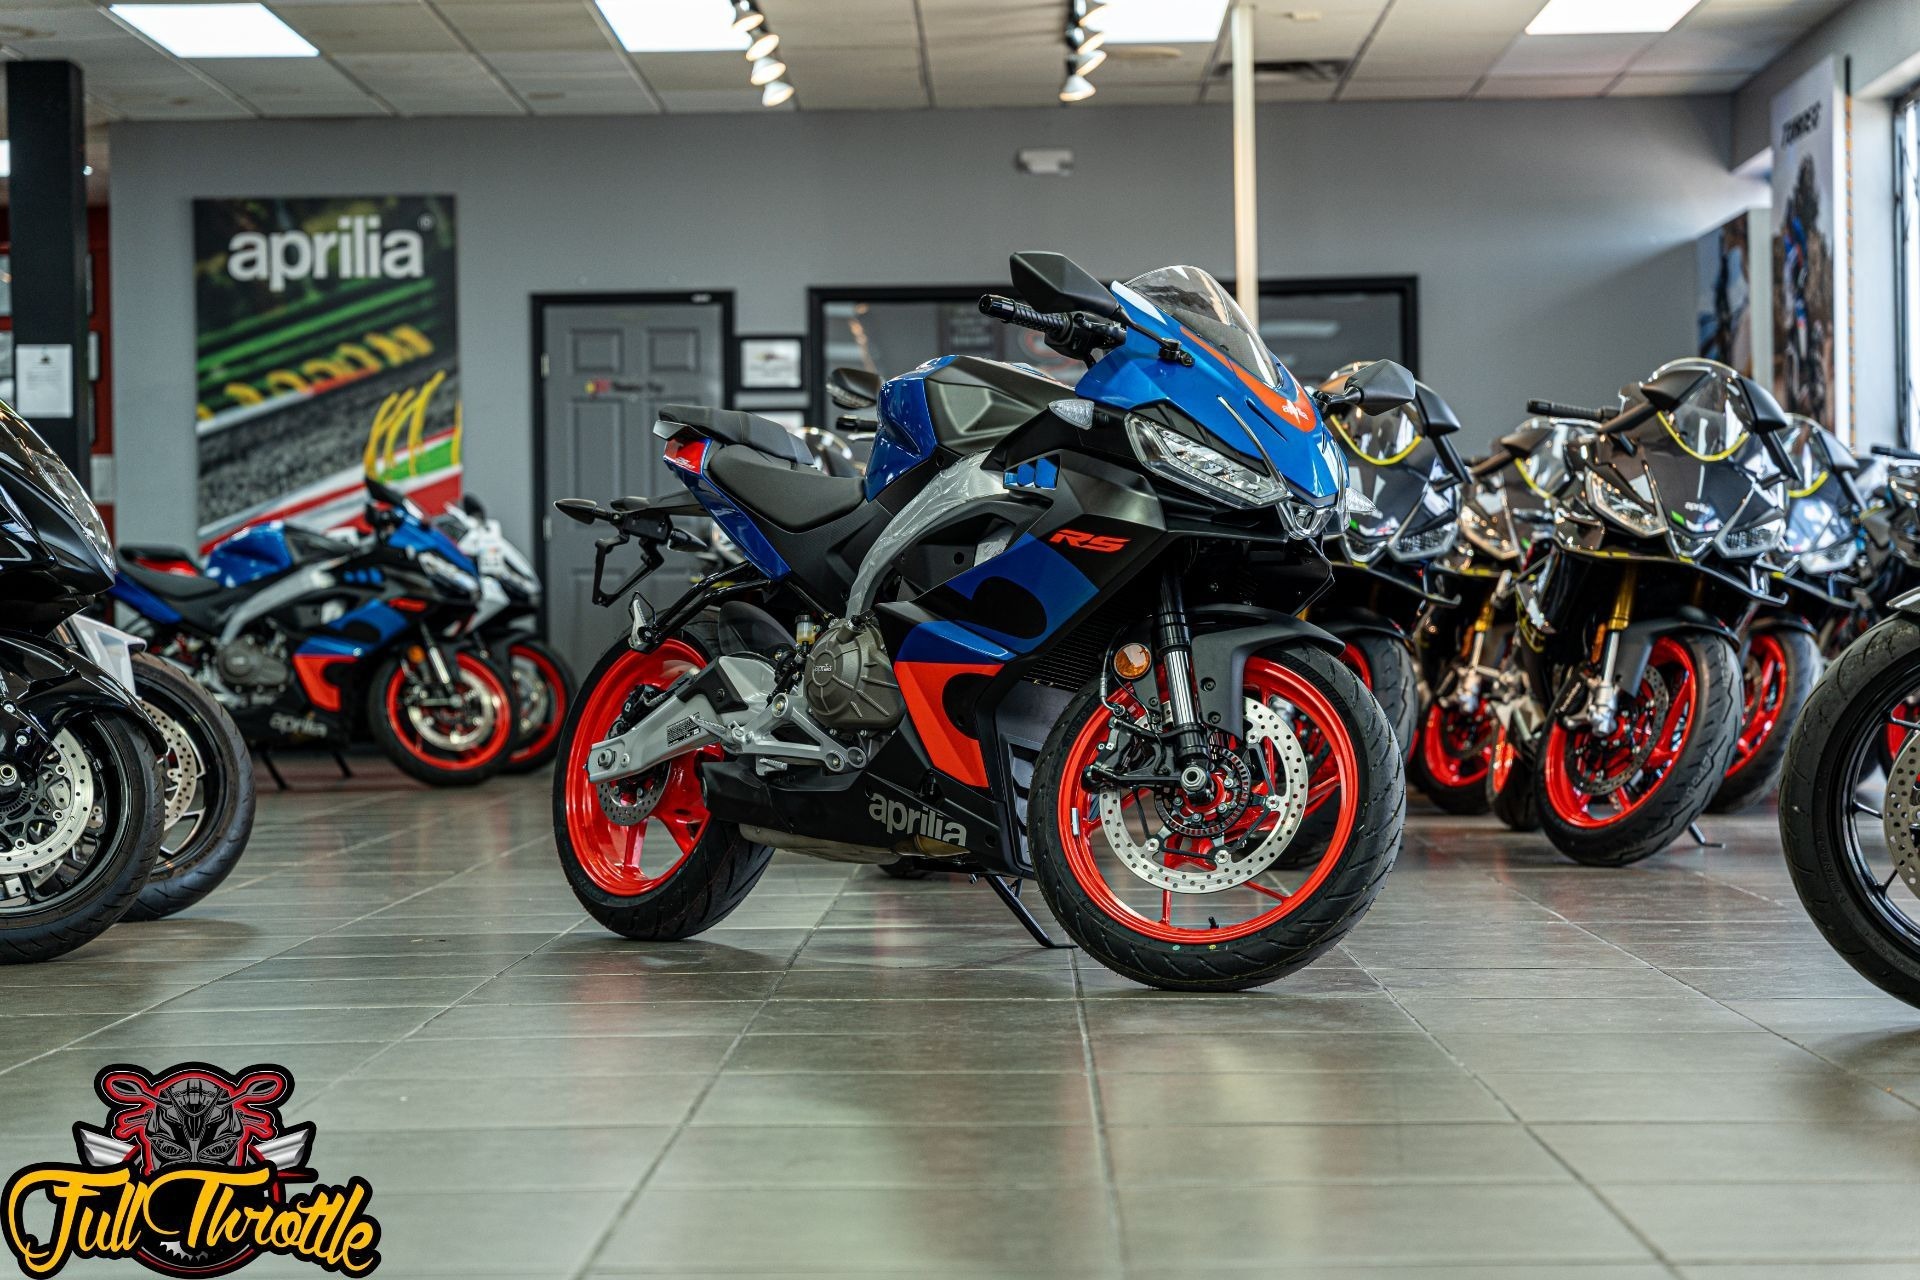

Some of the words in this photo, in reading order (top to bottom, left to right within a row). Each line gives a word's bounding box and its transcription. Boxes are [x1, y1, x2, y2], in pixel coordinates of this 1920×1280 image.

[227, 214, 424, 292] aprilia
[1049, 529, 1131, 553] RS
[868, 792, 968, 848] aprilia
